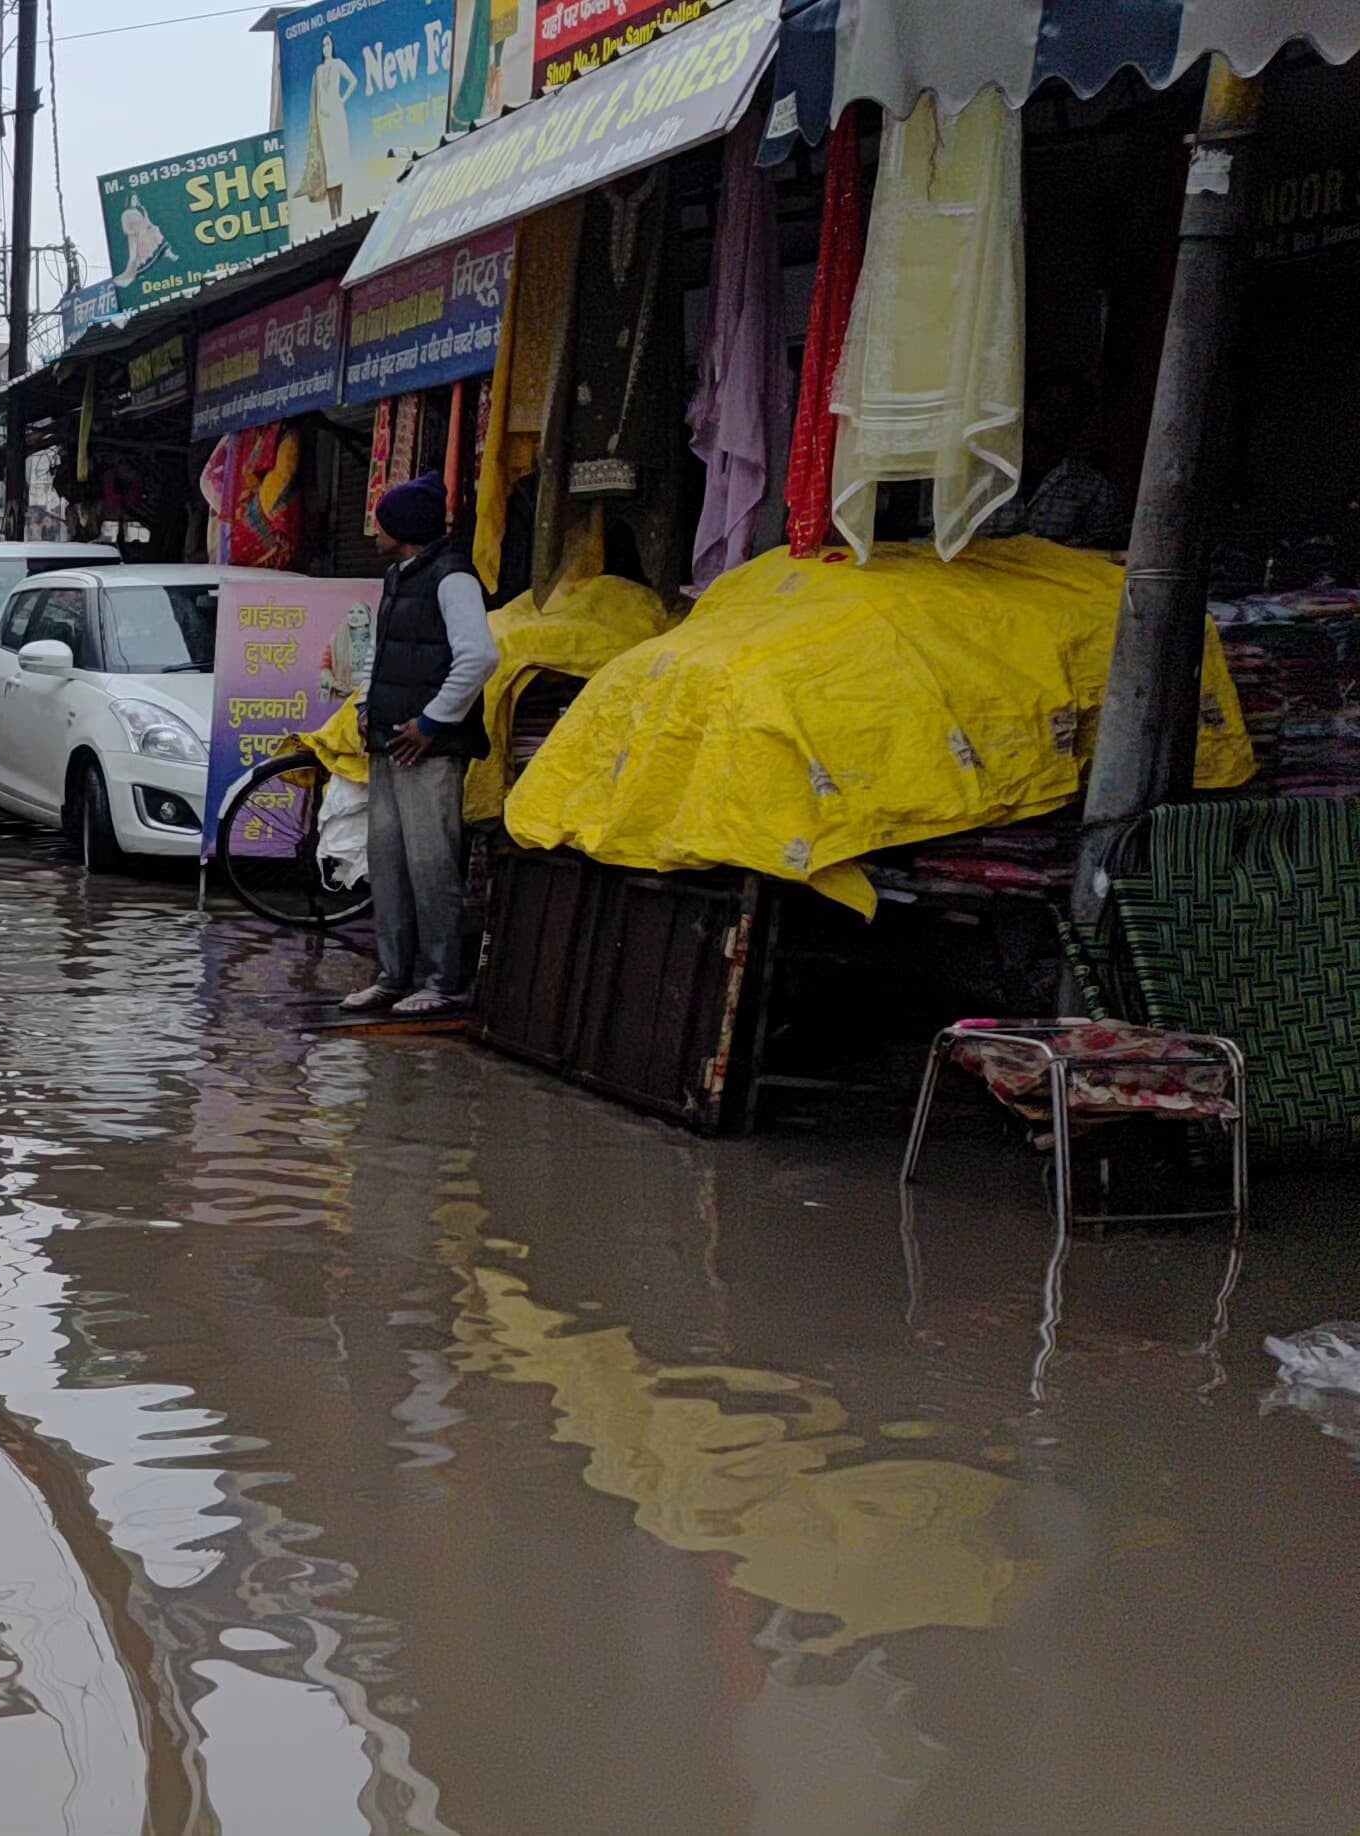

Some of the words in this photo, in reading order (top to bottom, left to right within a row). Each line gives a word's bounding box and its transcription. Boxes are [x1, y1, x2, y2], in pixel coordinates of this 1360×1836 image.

[362, 41, 421, 97] New
[546, 61, 572, 87] Shop
[616, 13, 767, 132] SAREES
[104, 180, 124, 195] M.
[129, 147, 238, 188] 98139-33051
[184, 156, 288, 213] SHA
[142, 273, 184, 294] Deals
[228, 690, 308, 728] फुलकारी
